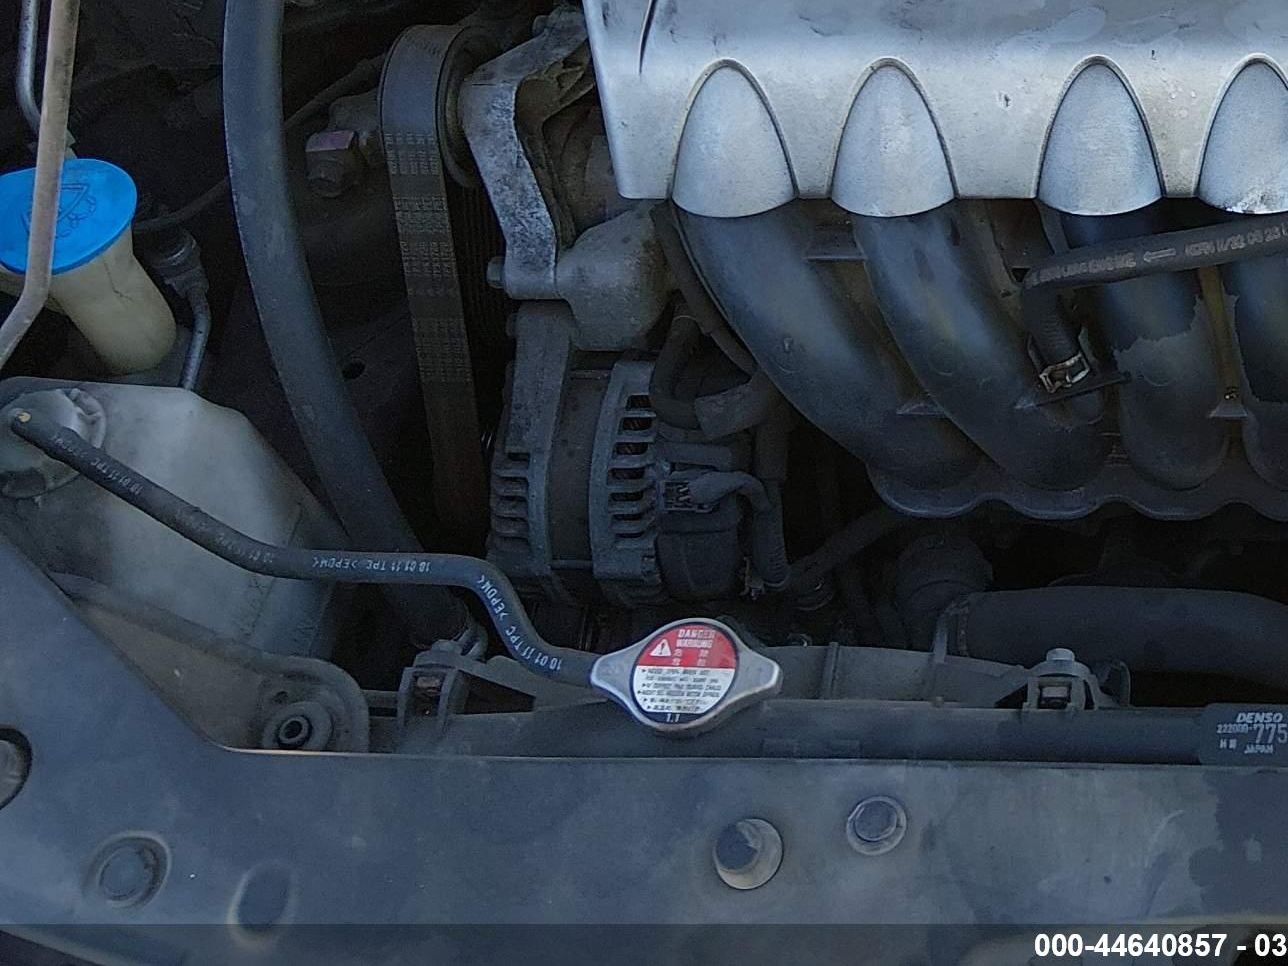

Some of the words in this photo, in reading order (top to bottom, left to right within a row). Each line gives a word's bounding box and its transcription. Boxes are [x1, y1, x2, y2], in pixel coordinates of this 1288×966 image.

[505, 625, 525, 651] TPC
[665, 713, 681, 723] 1.1
[1236, 712, 1284, 723] DENSO
